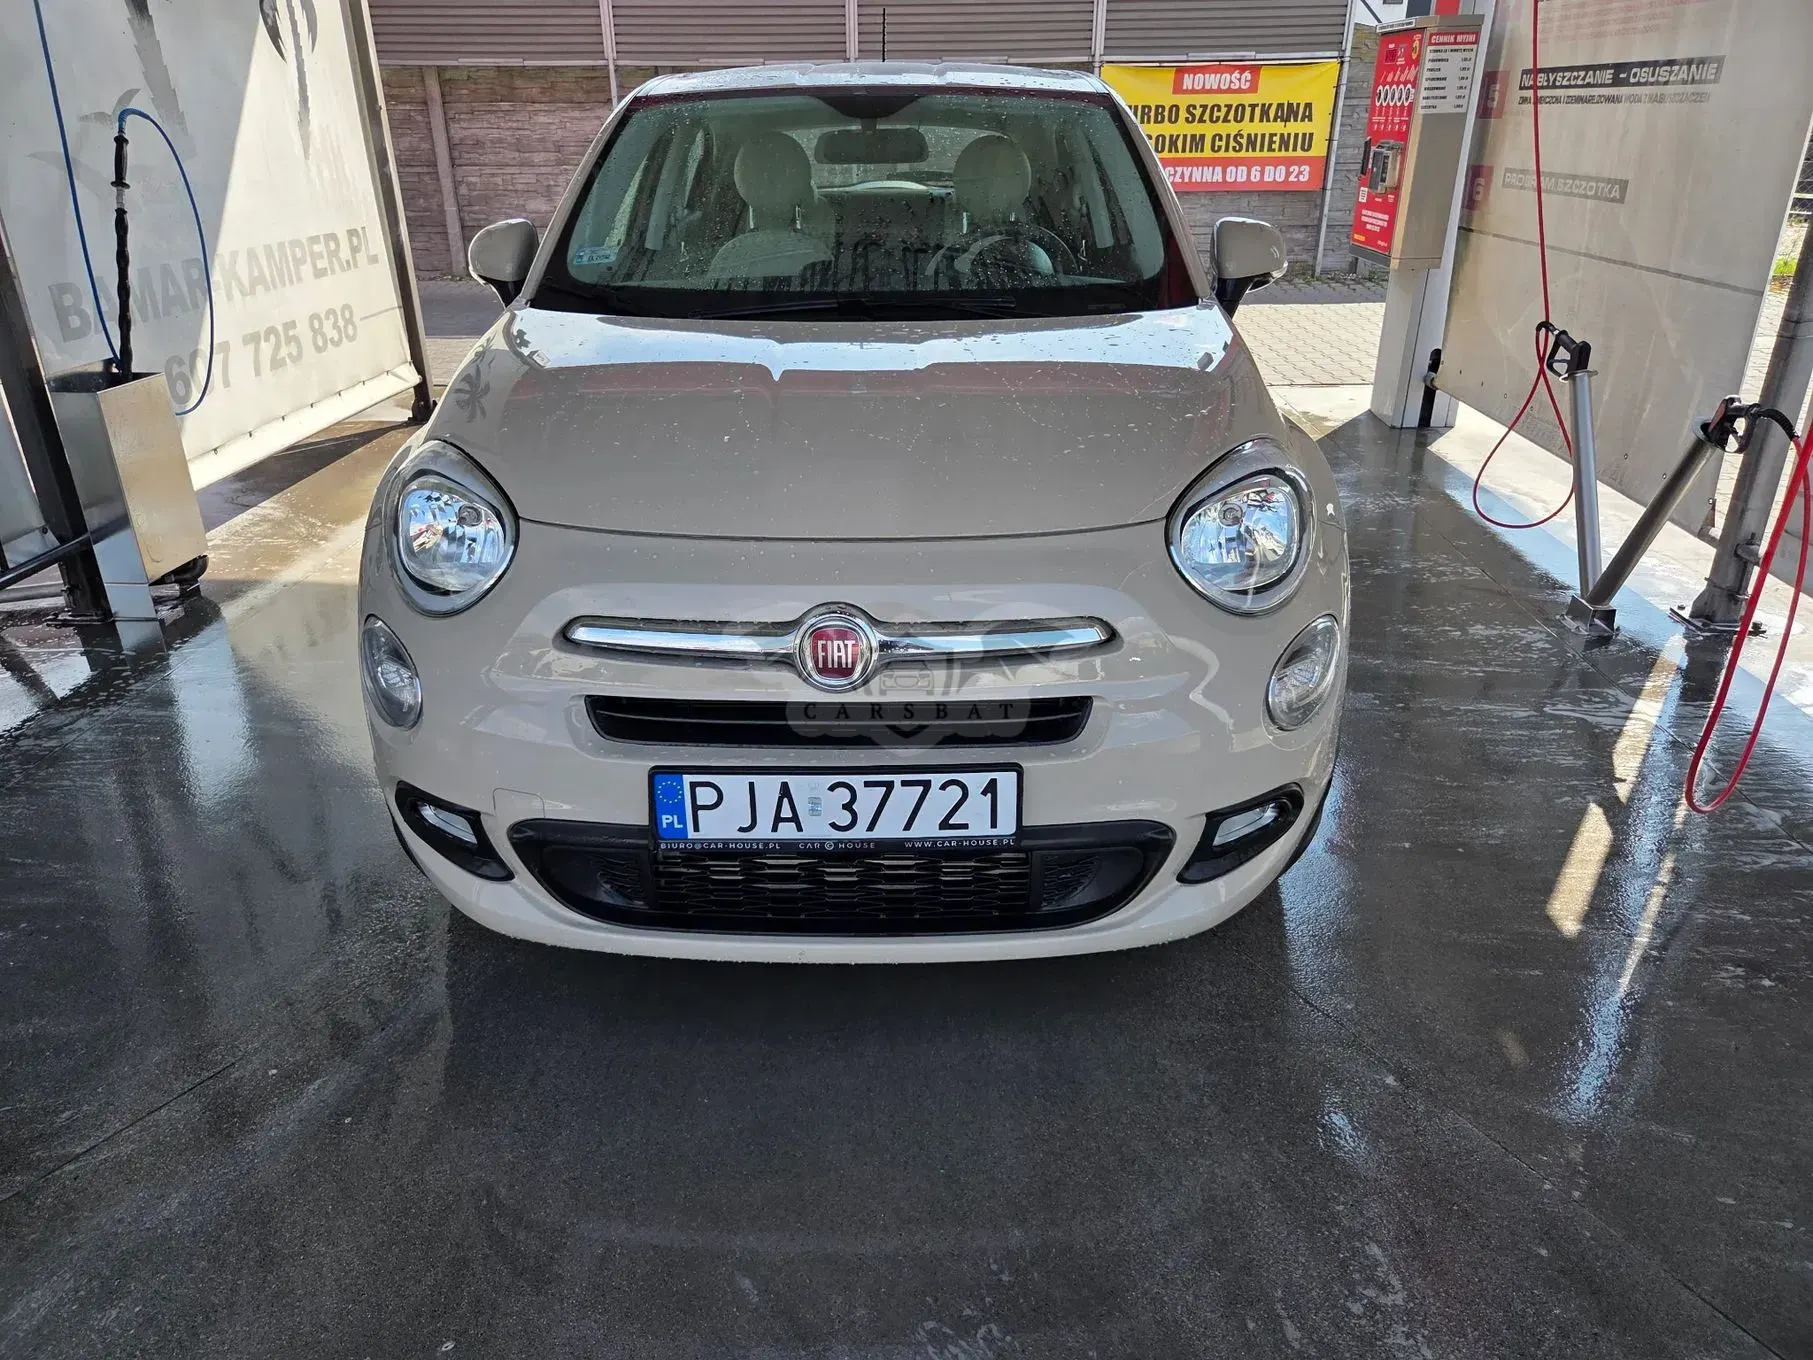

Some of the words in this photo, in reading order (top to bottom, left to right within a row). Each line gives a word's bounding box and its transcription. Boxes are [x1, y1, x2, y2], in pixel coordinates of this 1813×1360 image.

[1182, 70, 1251, 90] NOWOŚĆ
[1521, 69, 1615, 87] NABŁYSZCZANIE
[1629, 63, 1718, 83] OSUSZANIE
[1210, 129, 1315, 154] CIŚNIENIU
[1226, 166, 1247, 183] OD
[1250, 166, 1262, 183] 6
[1264, 166, 1286, 182] DO
[1288, 165, 1310, 182] 23
[1557, 179, 1620, 199] SZCZOTKA
[242, 319, 304, 377] 725
[309, 303, 358, 353] 838
[817, 640, 856, 669] FIAT
[689, 781, 804, 833] PJA
[827, 778, 998, 833] 37721
[661, 814, 683, 829] PL
[660, 842, 781, 850] BIURO@CAR-HOUSE.PL
[904, 839, 1015, 849] WWW.CAR-HOUSE.PL
